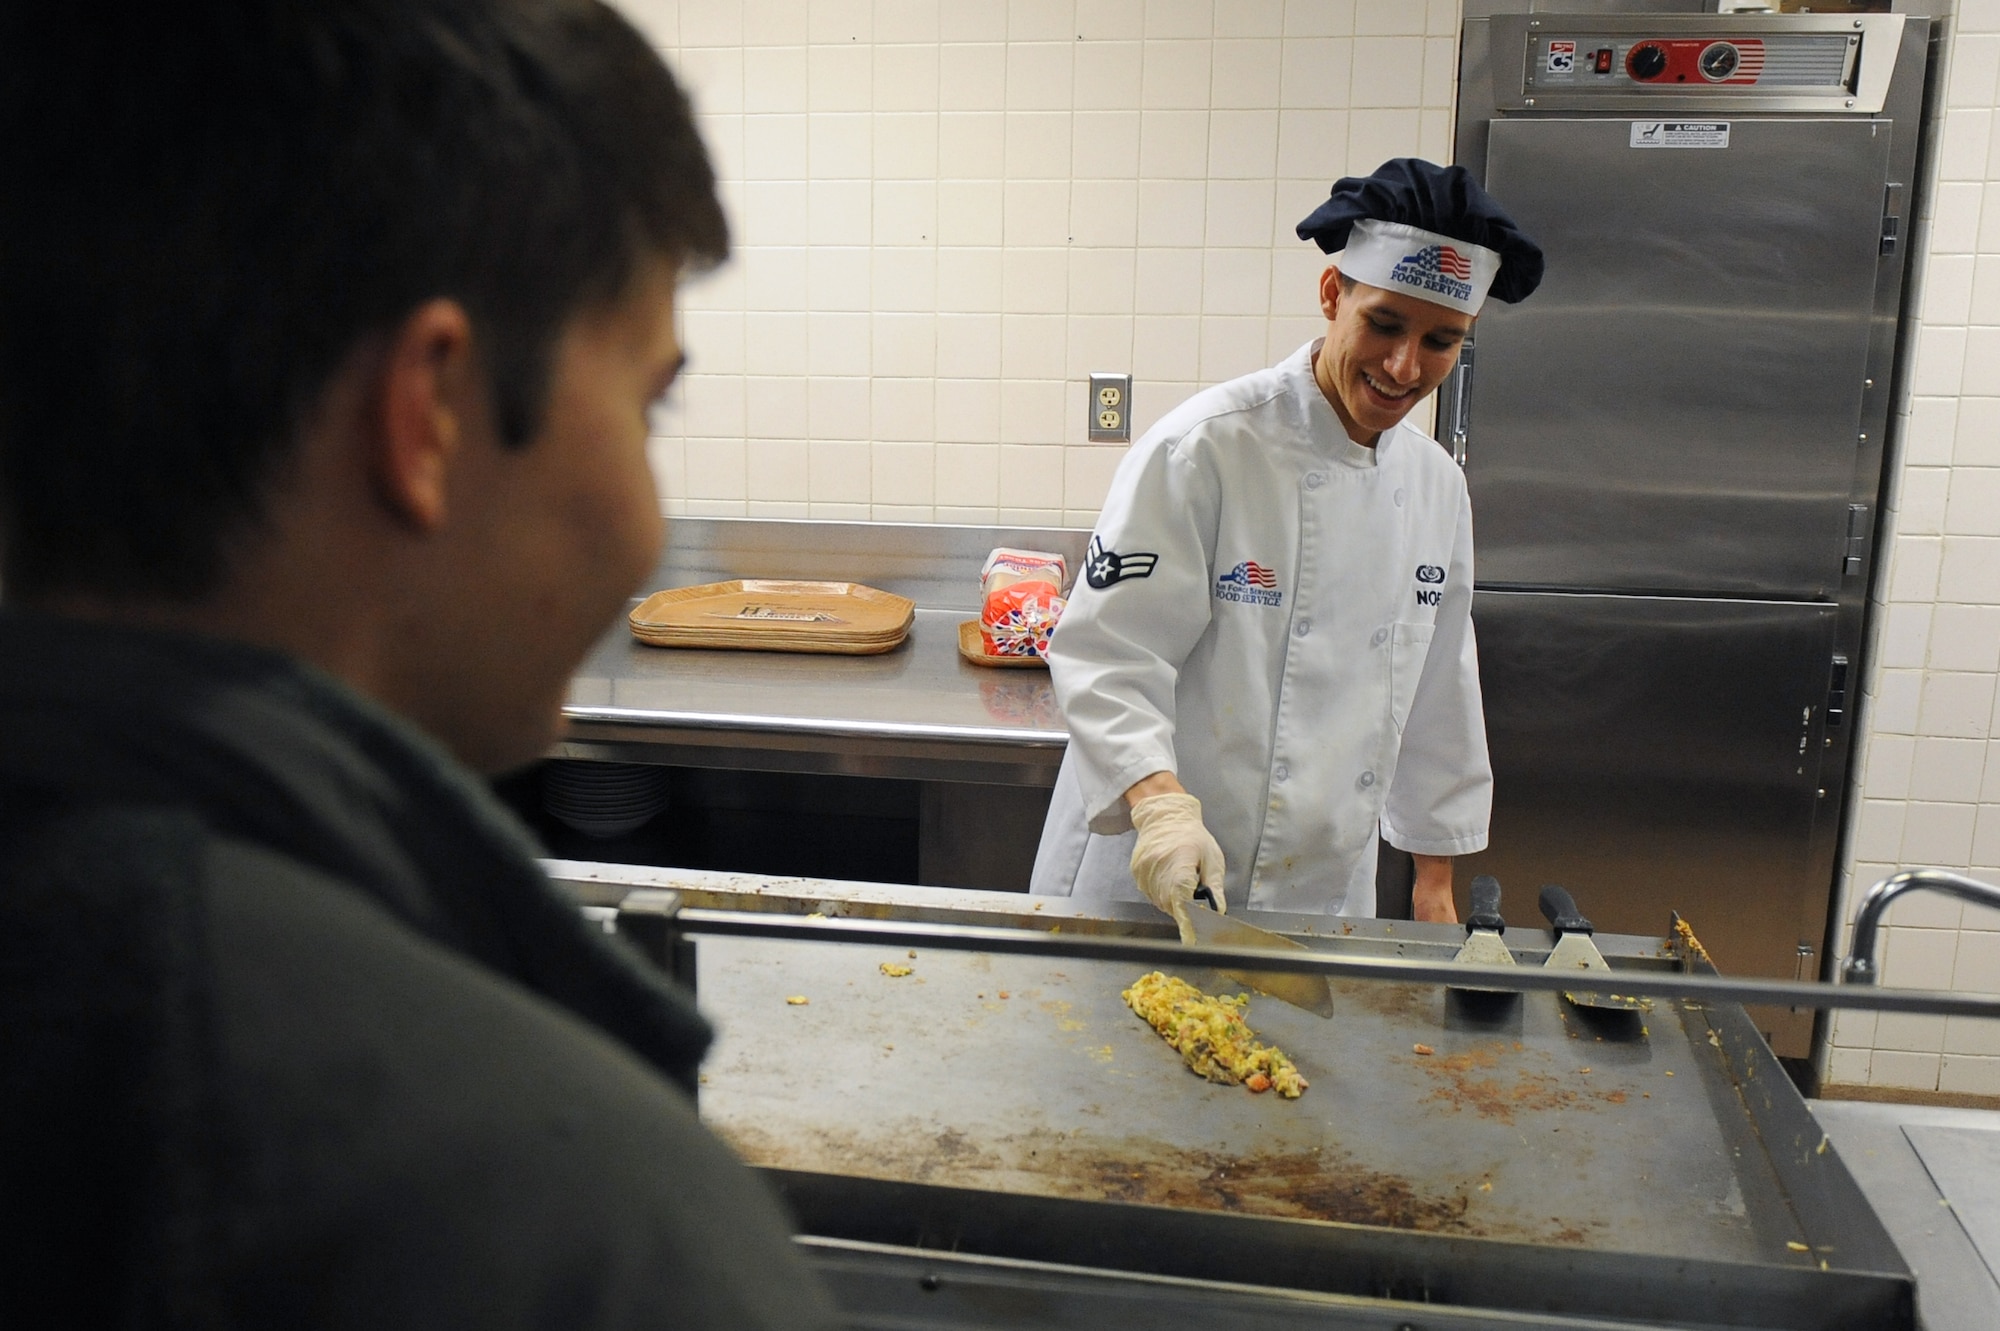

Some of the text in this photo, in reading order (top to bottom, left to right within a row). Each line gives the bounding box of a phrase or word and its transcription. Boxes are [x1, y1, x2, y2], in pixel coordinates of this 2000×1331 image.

[1390, 270, 1471, 301] FOOD SERVICE
[1393, 263, 1472, 292] AIR FORCE SERVICES
